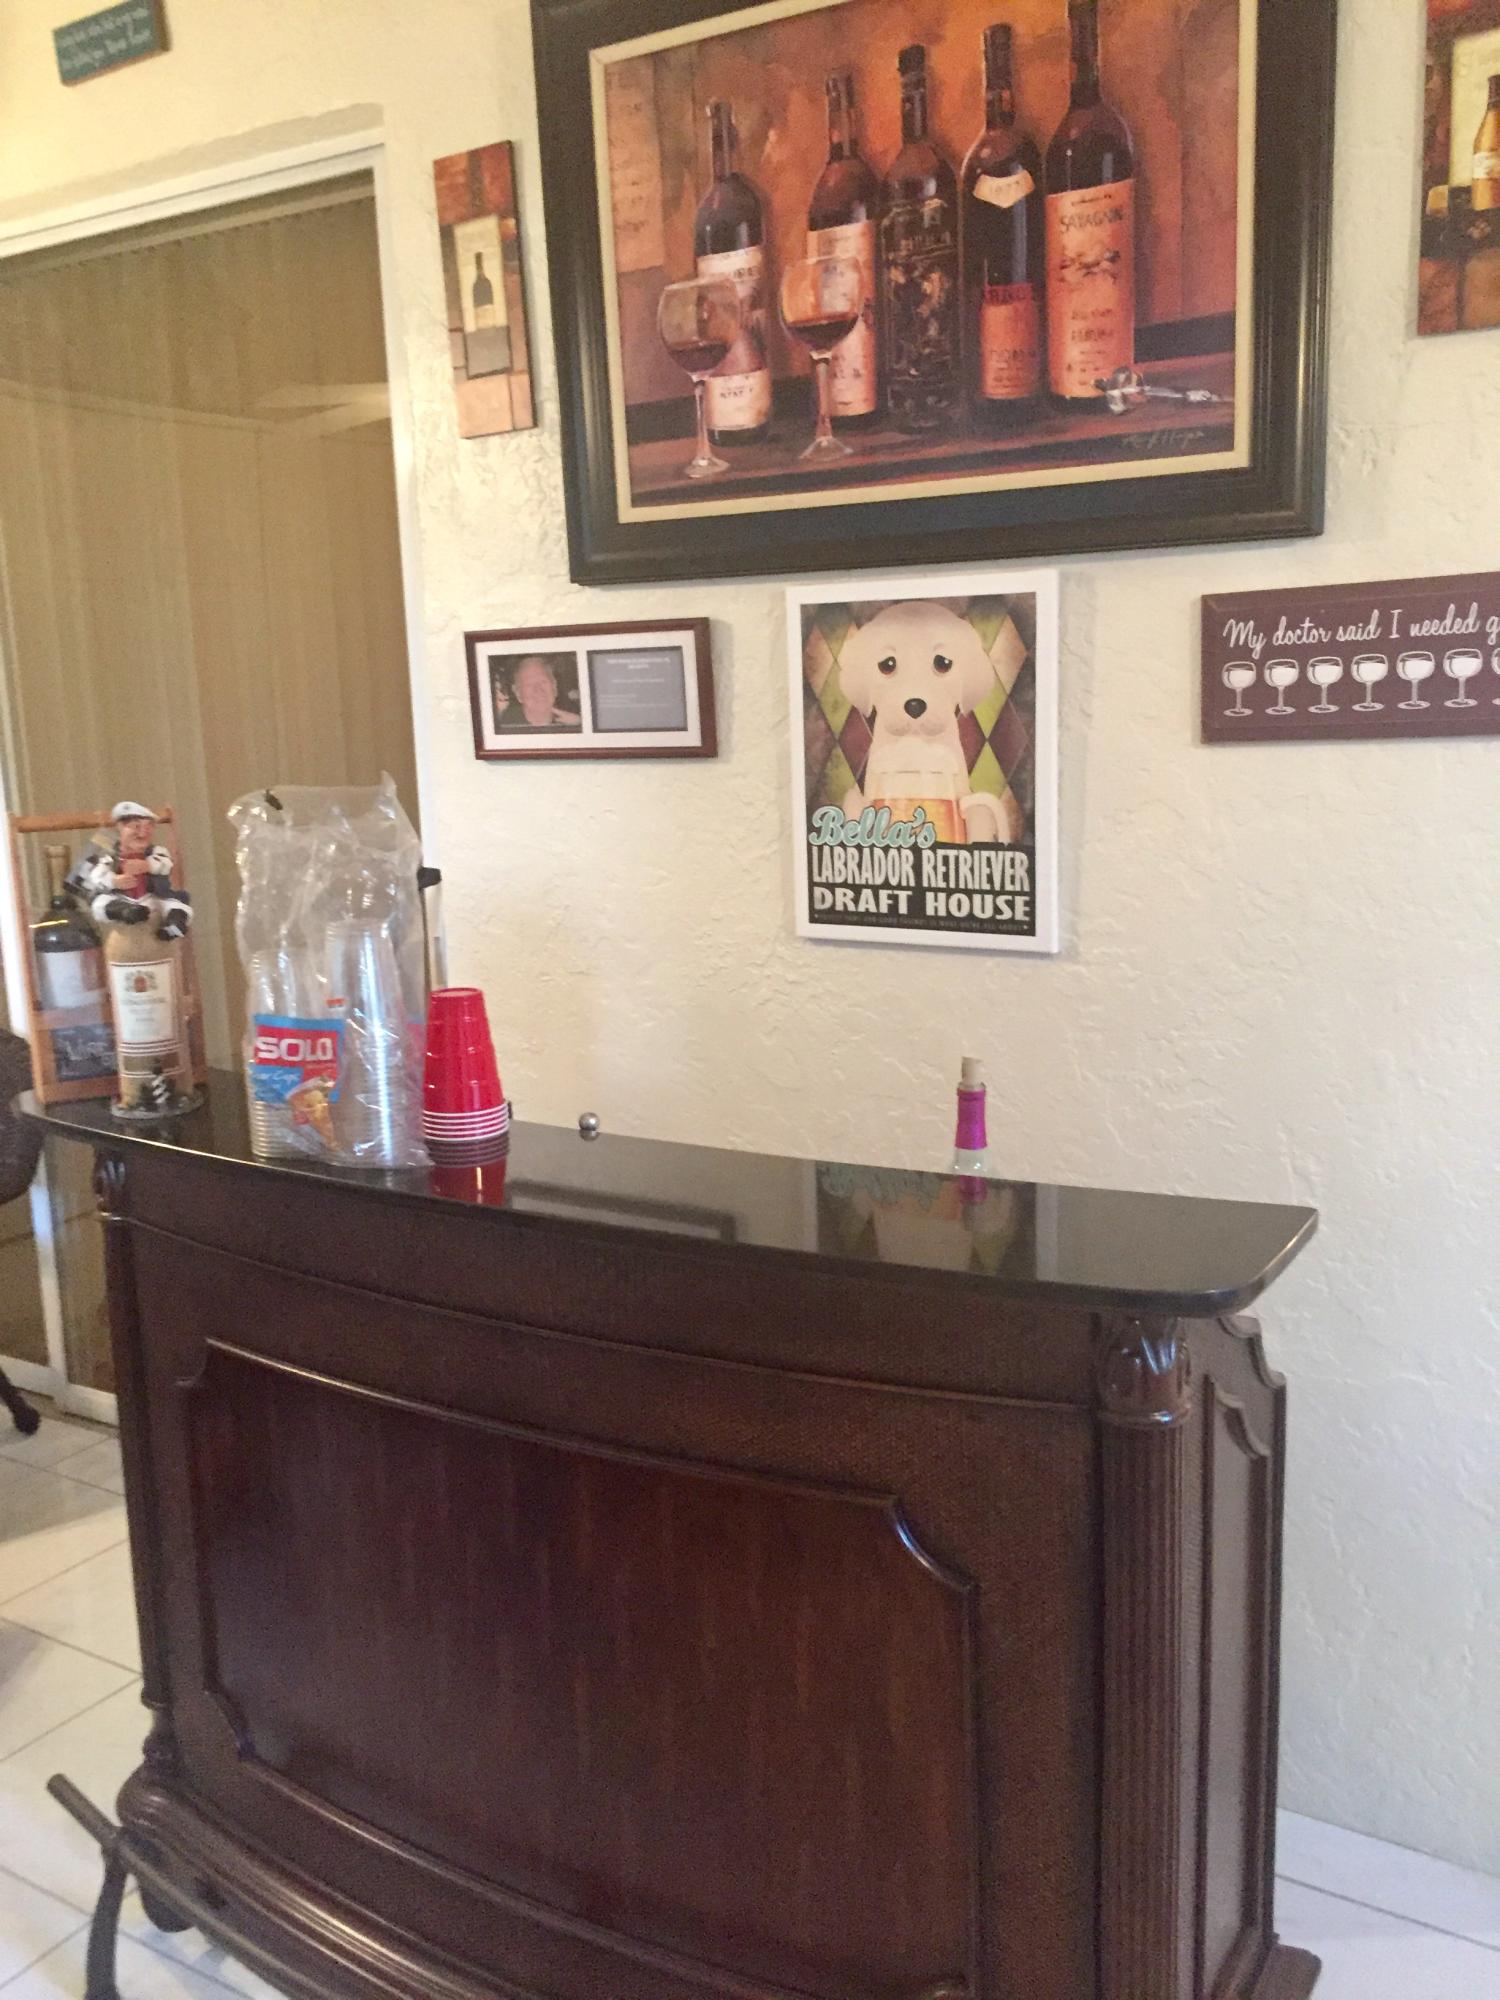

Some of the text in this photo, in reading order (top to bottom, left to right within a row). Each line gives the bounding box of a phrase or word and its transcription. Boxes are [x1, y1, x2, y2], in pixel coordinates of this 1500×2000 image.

[1223, 618, 1266, 660] My
[1272, 615, 1331, 646] doctor
[1336, 608, 1381, 642] said
[1389, 609, 1402, 639] I
[1410, 601, 1480, 637] needed
[808, 805, 936, 848] Bella's
[812, 845, 1031, 892] LABRADOR RETRIEVER
[813, 886, 1031, 921] DRAFT HOUSE
[256, 1036, 334, 1062] SOLO
